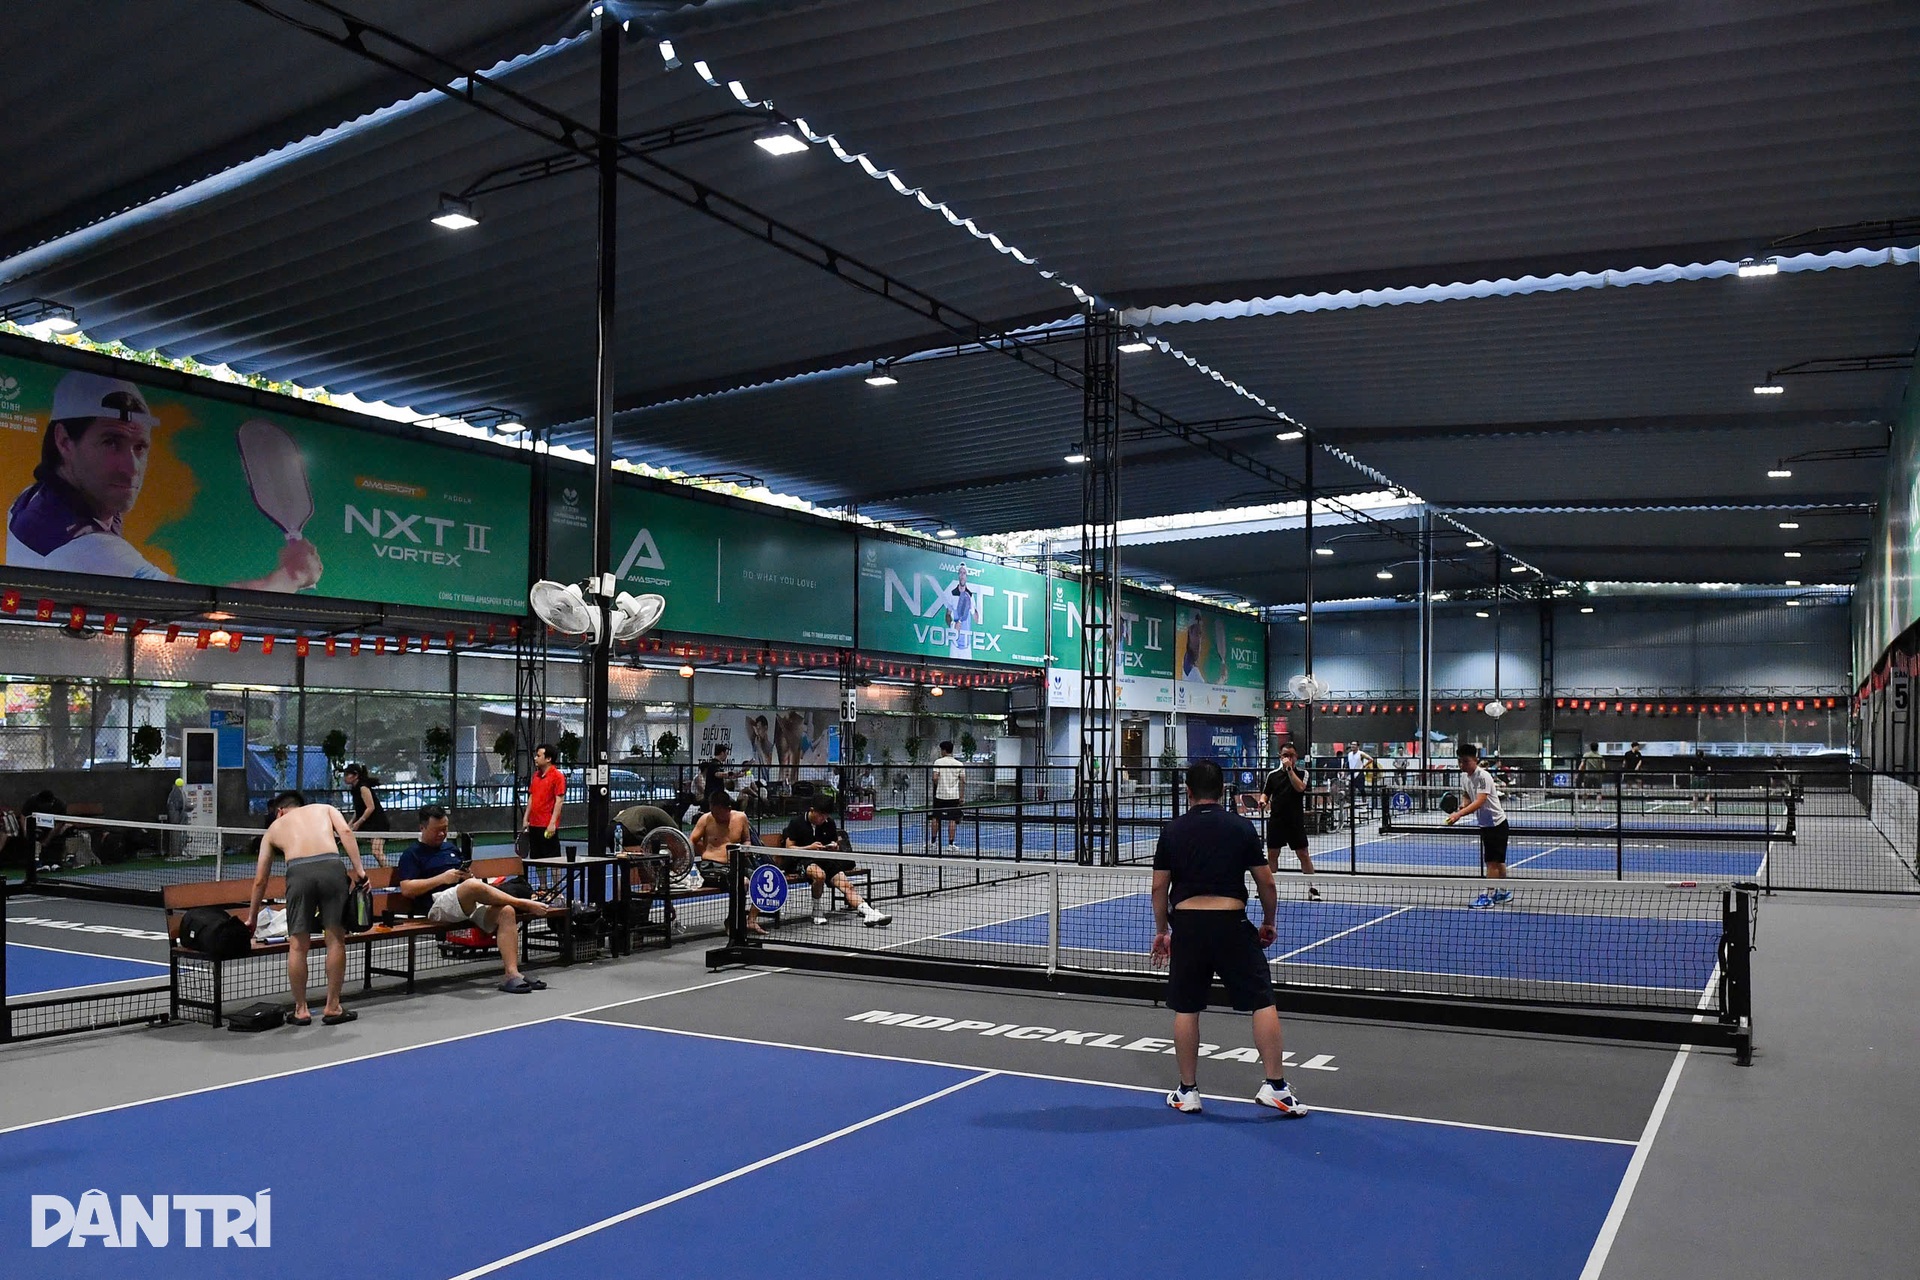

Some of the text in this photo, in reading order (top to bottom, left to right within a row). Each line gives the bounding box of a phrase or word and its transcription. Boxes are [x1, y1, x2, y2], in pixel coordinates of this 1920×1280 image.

[344, 504, 491, 554] NXT II
[372, 543, 462, 567] VORTEX
[628, 575, 671, 587] AMASPORT
[757, 572, 777, 583] WHAT
[780, 576, 794, 586] YOU
[1002, 589, 1029, 632] II
[914, 623, 1001, 652] VORTEX
[1144, 616, 1162, 651] II
[1231, 647, 1252, 662] NXT
[1895, 683, 1908, 709] 5
[841, 701, 848, 719] 6
[850, 701, 855, 719] 6
[1167, 713, 1172, 726] 8
[763, 870, 774, 893] 3
